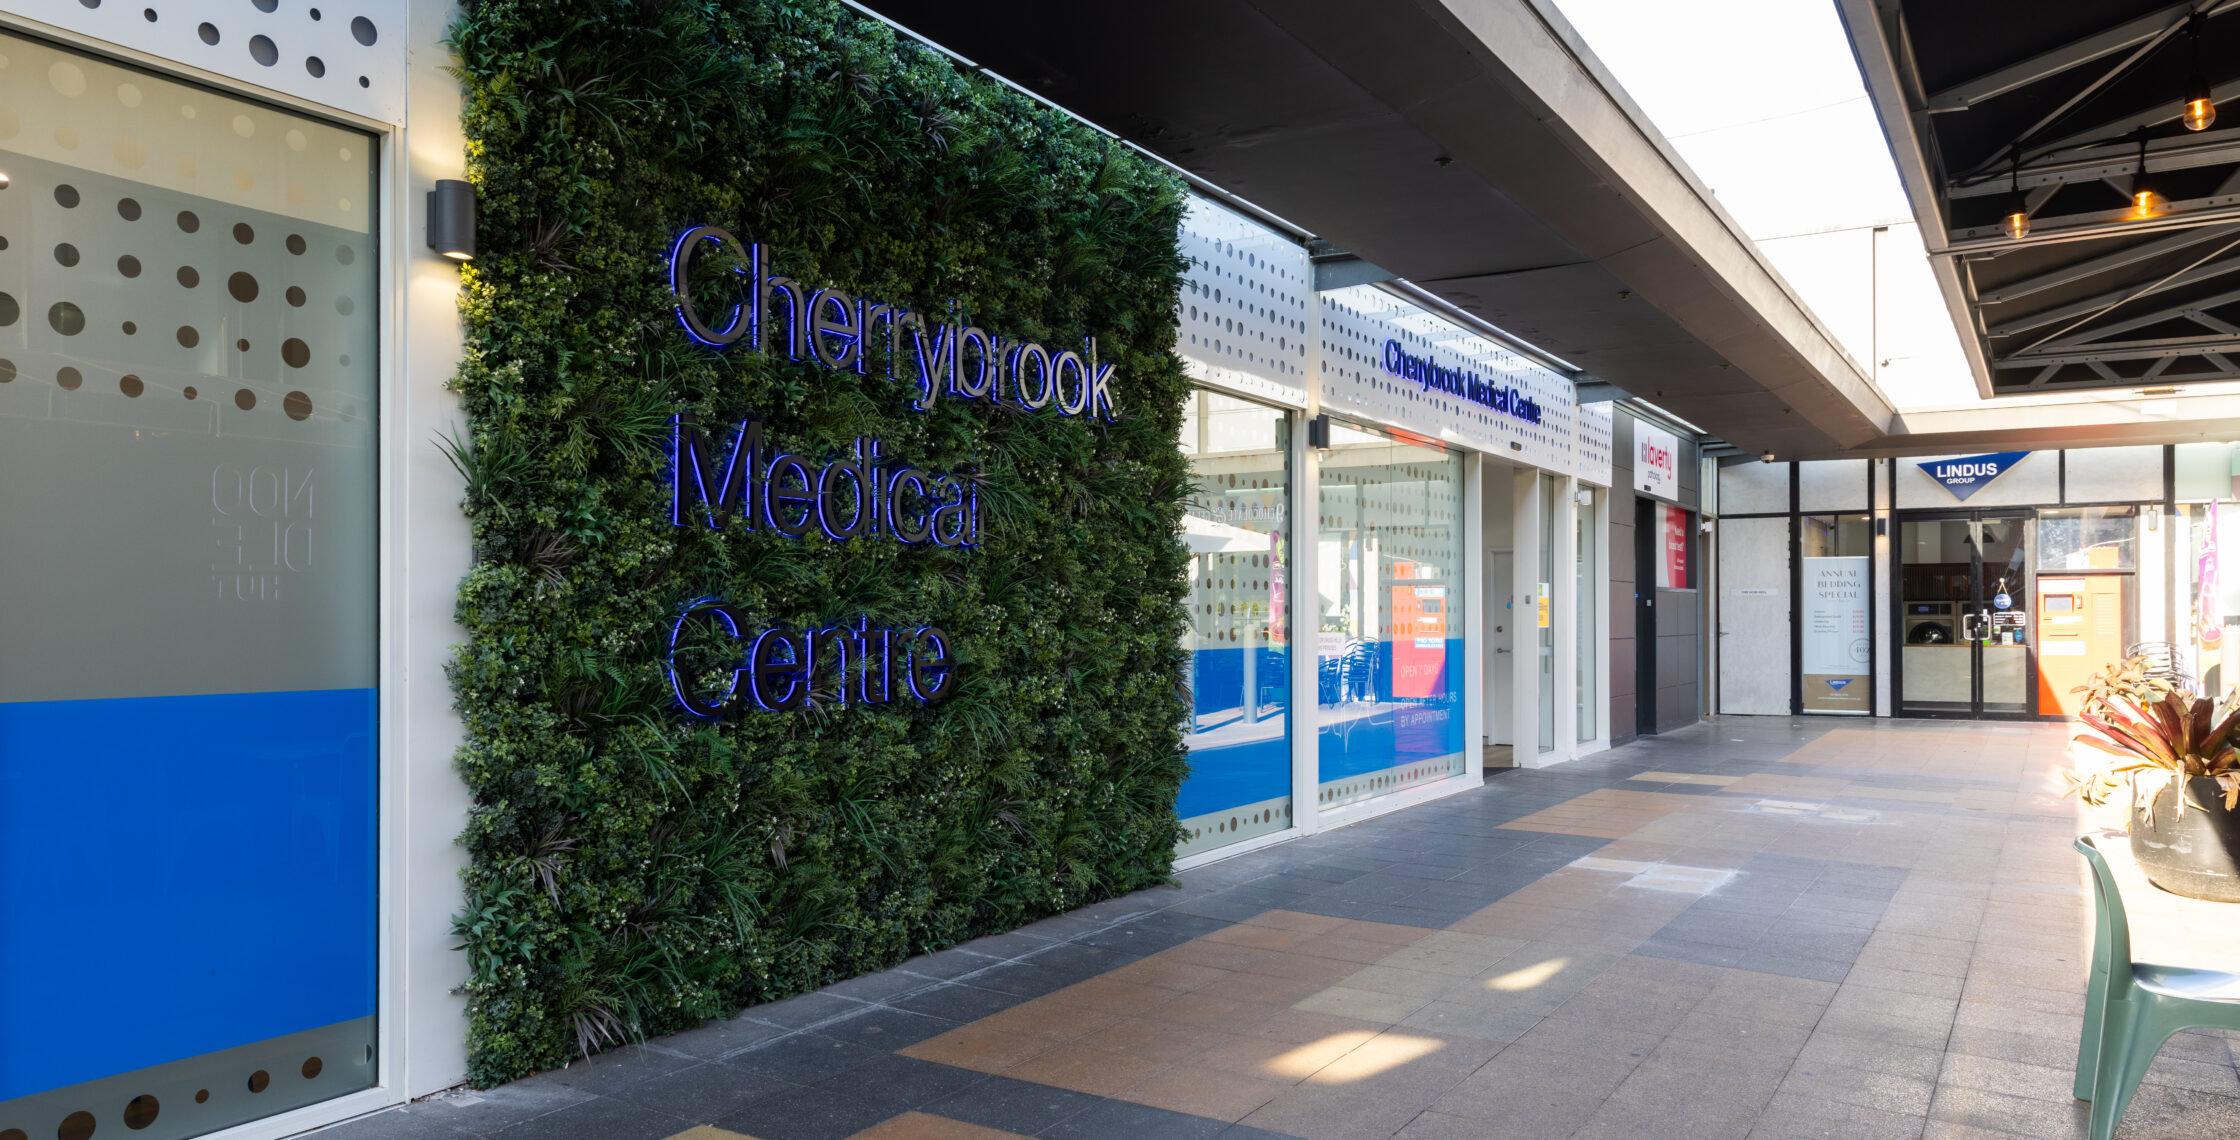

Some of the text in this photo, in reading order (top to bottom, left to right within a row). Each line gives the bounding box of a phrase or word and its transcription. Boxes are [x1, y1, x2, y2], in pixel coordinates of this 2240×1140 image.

[670, 226, 1118, 422] Cherrybrook
[1383, 338, 1542, 425] Cherrybrook Medical Centre
[1647, 435, 1672, 480] laverty
[1937, 463, 1998, 478] LINDUS
[673, 413, 986, 548] Medical
[671, 599, 953, 717] Centre
[1401, 665, 1417, 678] OPEN
[1423, 663, 1439, 675] DAYS
[1401, 691, 1457, 710] OPEN AFTER HOURS
[1401, 709, 1450, 728] BY APPOINTMENT
